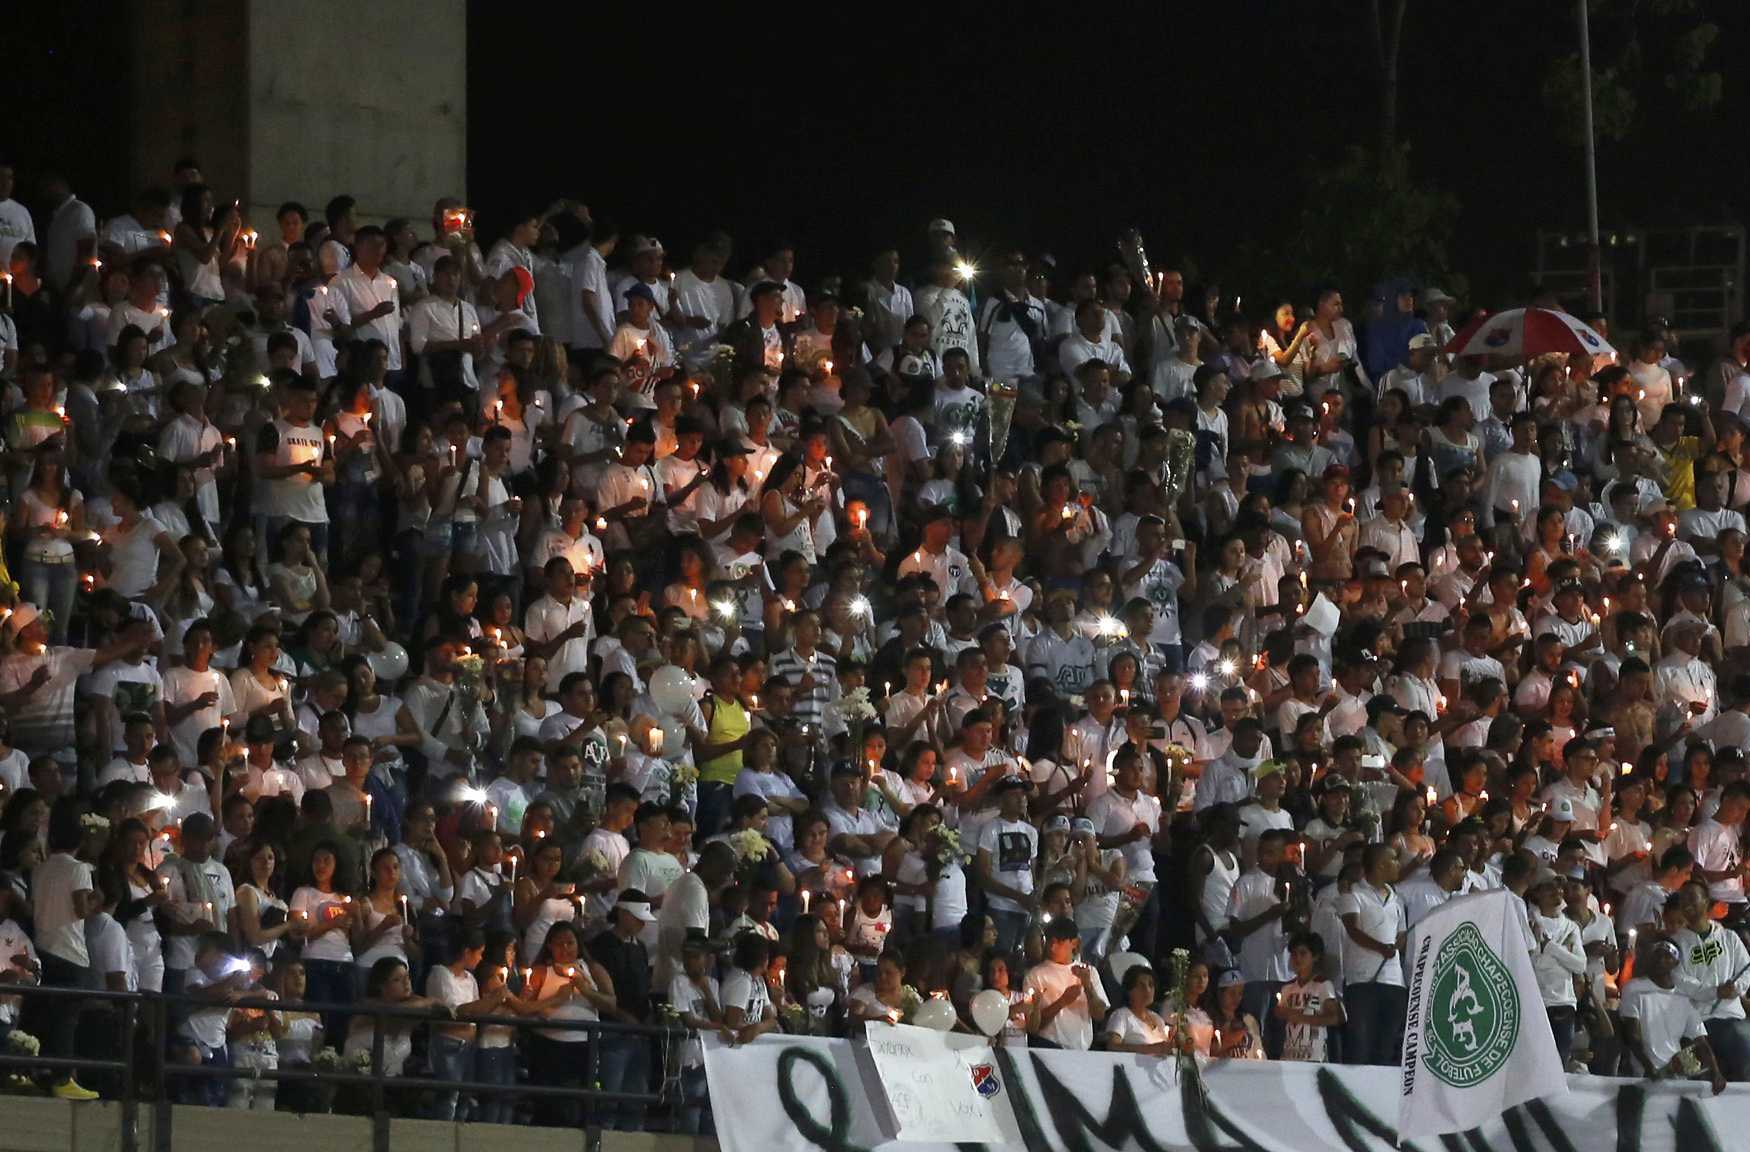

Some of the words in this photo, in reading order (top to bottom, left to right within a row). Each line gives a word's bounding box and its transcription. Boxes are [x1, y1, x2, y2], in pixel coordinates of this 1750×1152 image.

[1408, 935, 1432, 1027] CHAPECOENSE
[1435, 1054, 1482, 1081] FUTEBOL
[1481, 1051, 1501, 1069] DE
